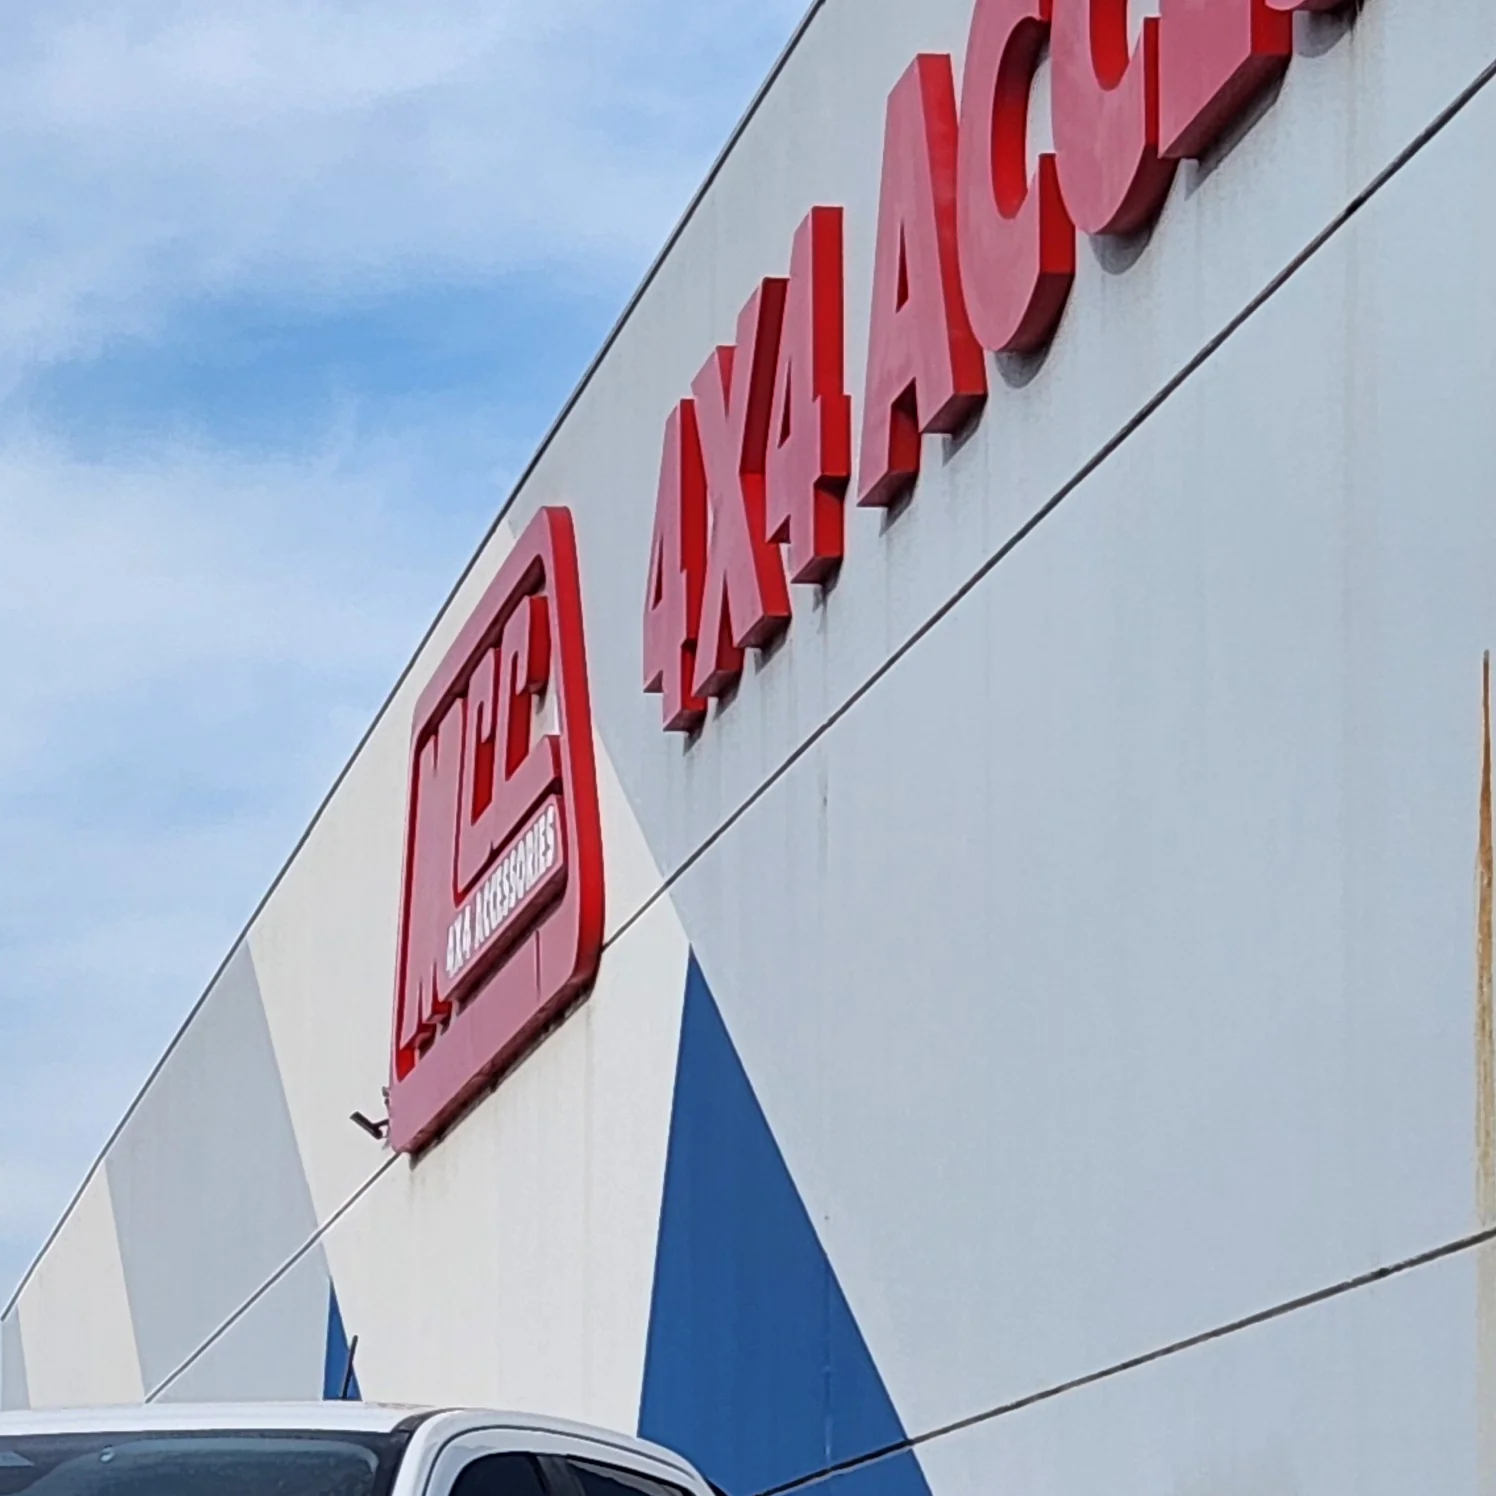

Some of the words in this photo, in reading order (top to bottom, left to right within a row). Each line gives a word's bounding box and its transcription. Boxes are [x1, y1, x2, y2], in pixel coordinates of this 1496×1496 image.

[643, 206, 851, 732] 4X4
[856, 0, 1349, 508] ACC
[446, 905, 472, 979] 4X4
[475, 805, 555, 949] ACCESSORIES
